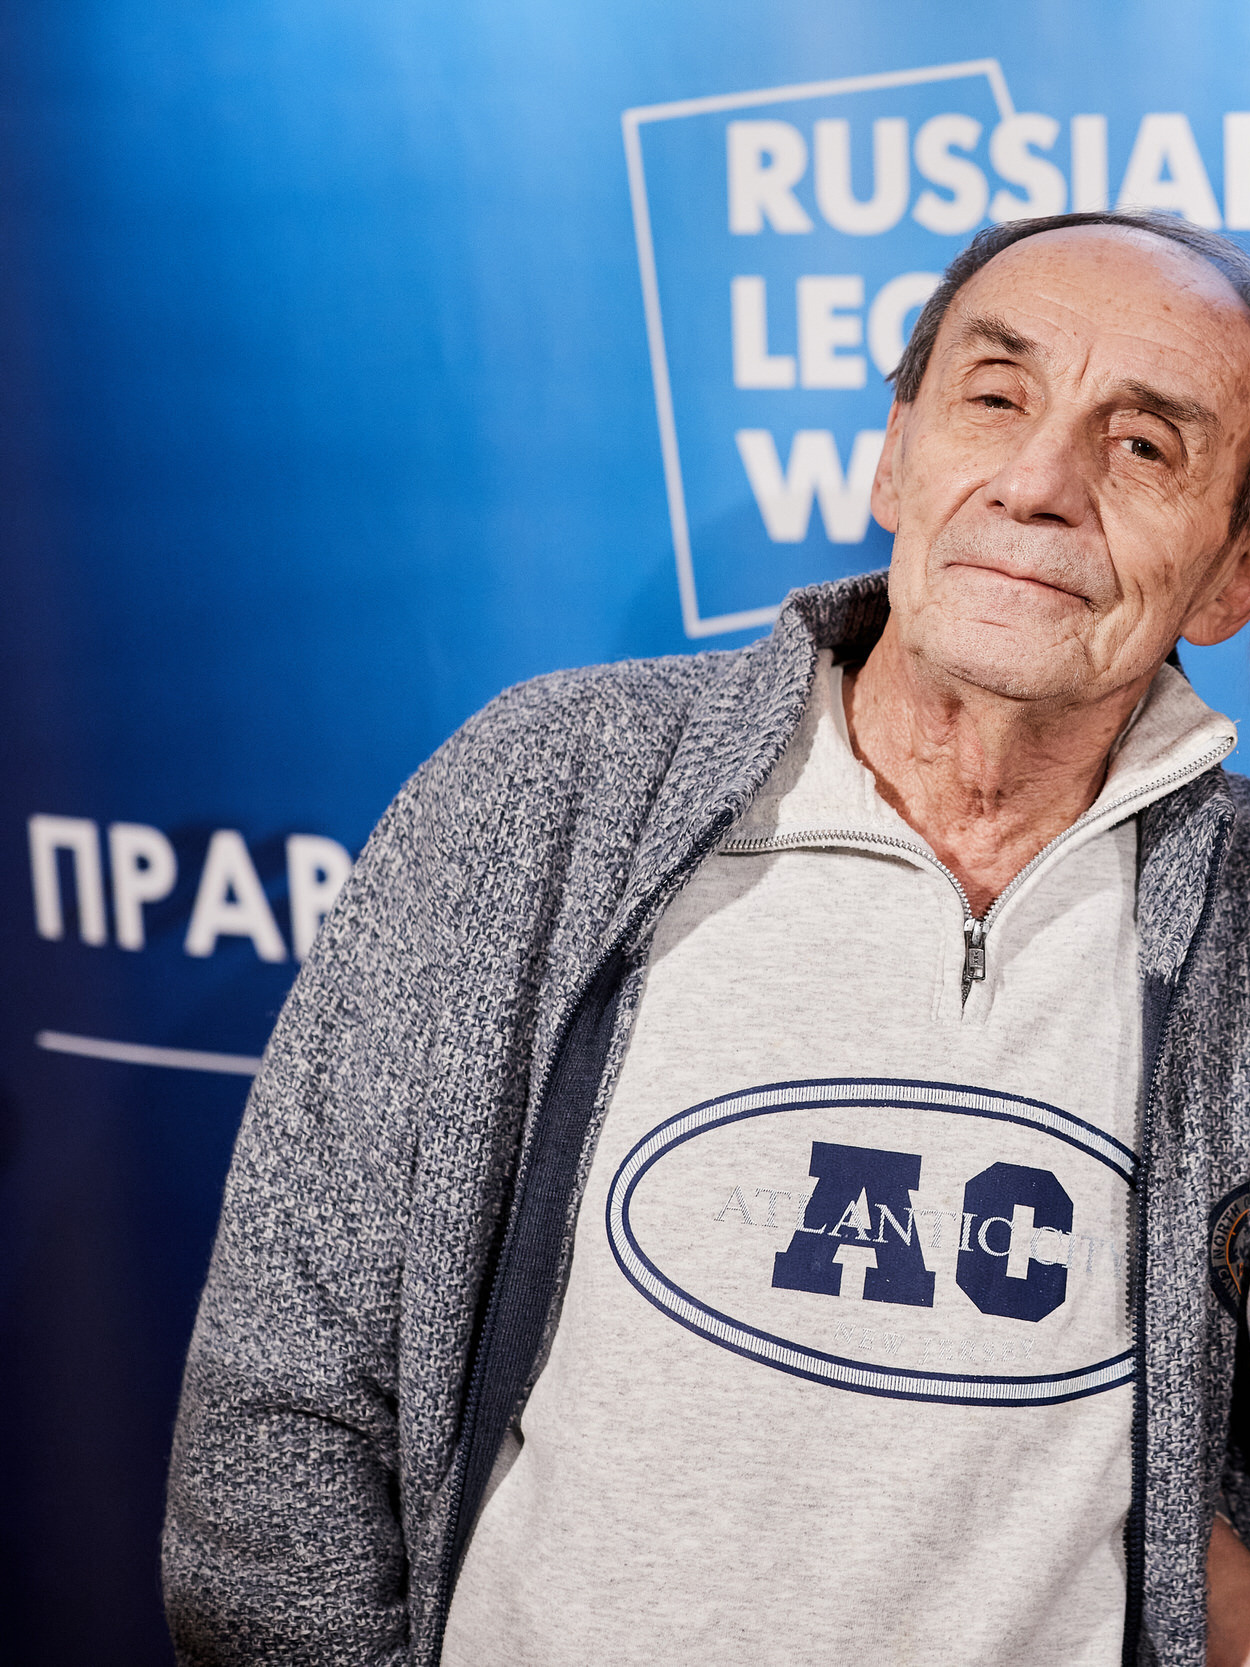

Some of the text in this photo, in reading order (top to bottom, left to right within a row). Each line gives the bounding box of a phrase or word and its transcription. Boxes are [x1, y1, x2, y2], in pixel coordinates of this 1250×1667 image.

[714, 1184, 1016, 1257] ATLANTIC
[1212, 1202, 1242, 1260] NORTH
[832, 1319, 1036, 1366] NEW JERSEY
